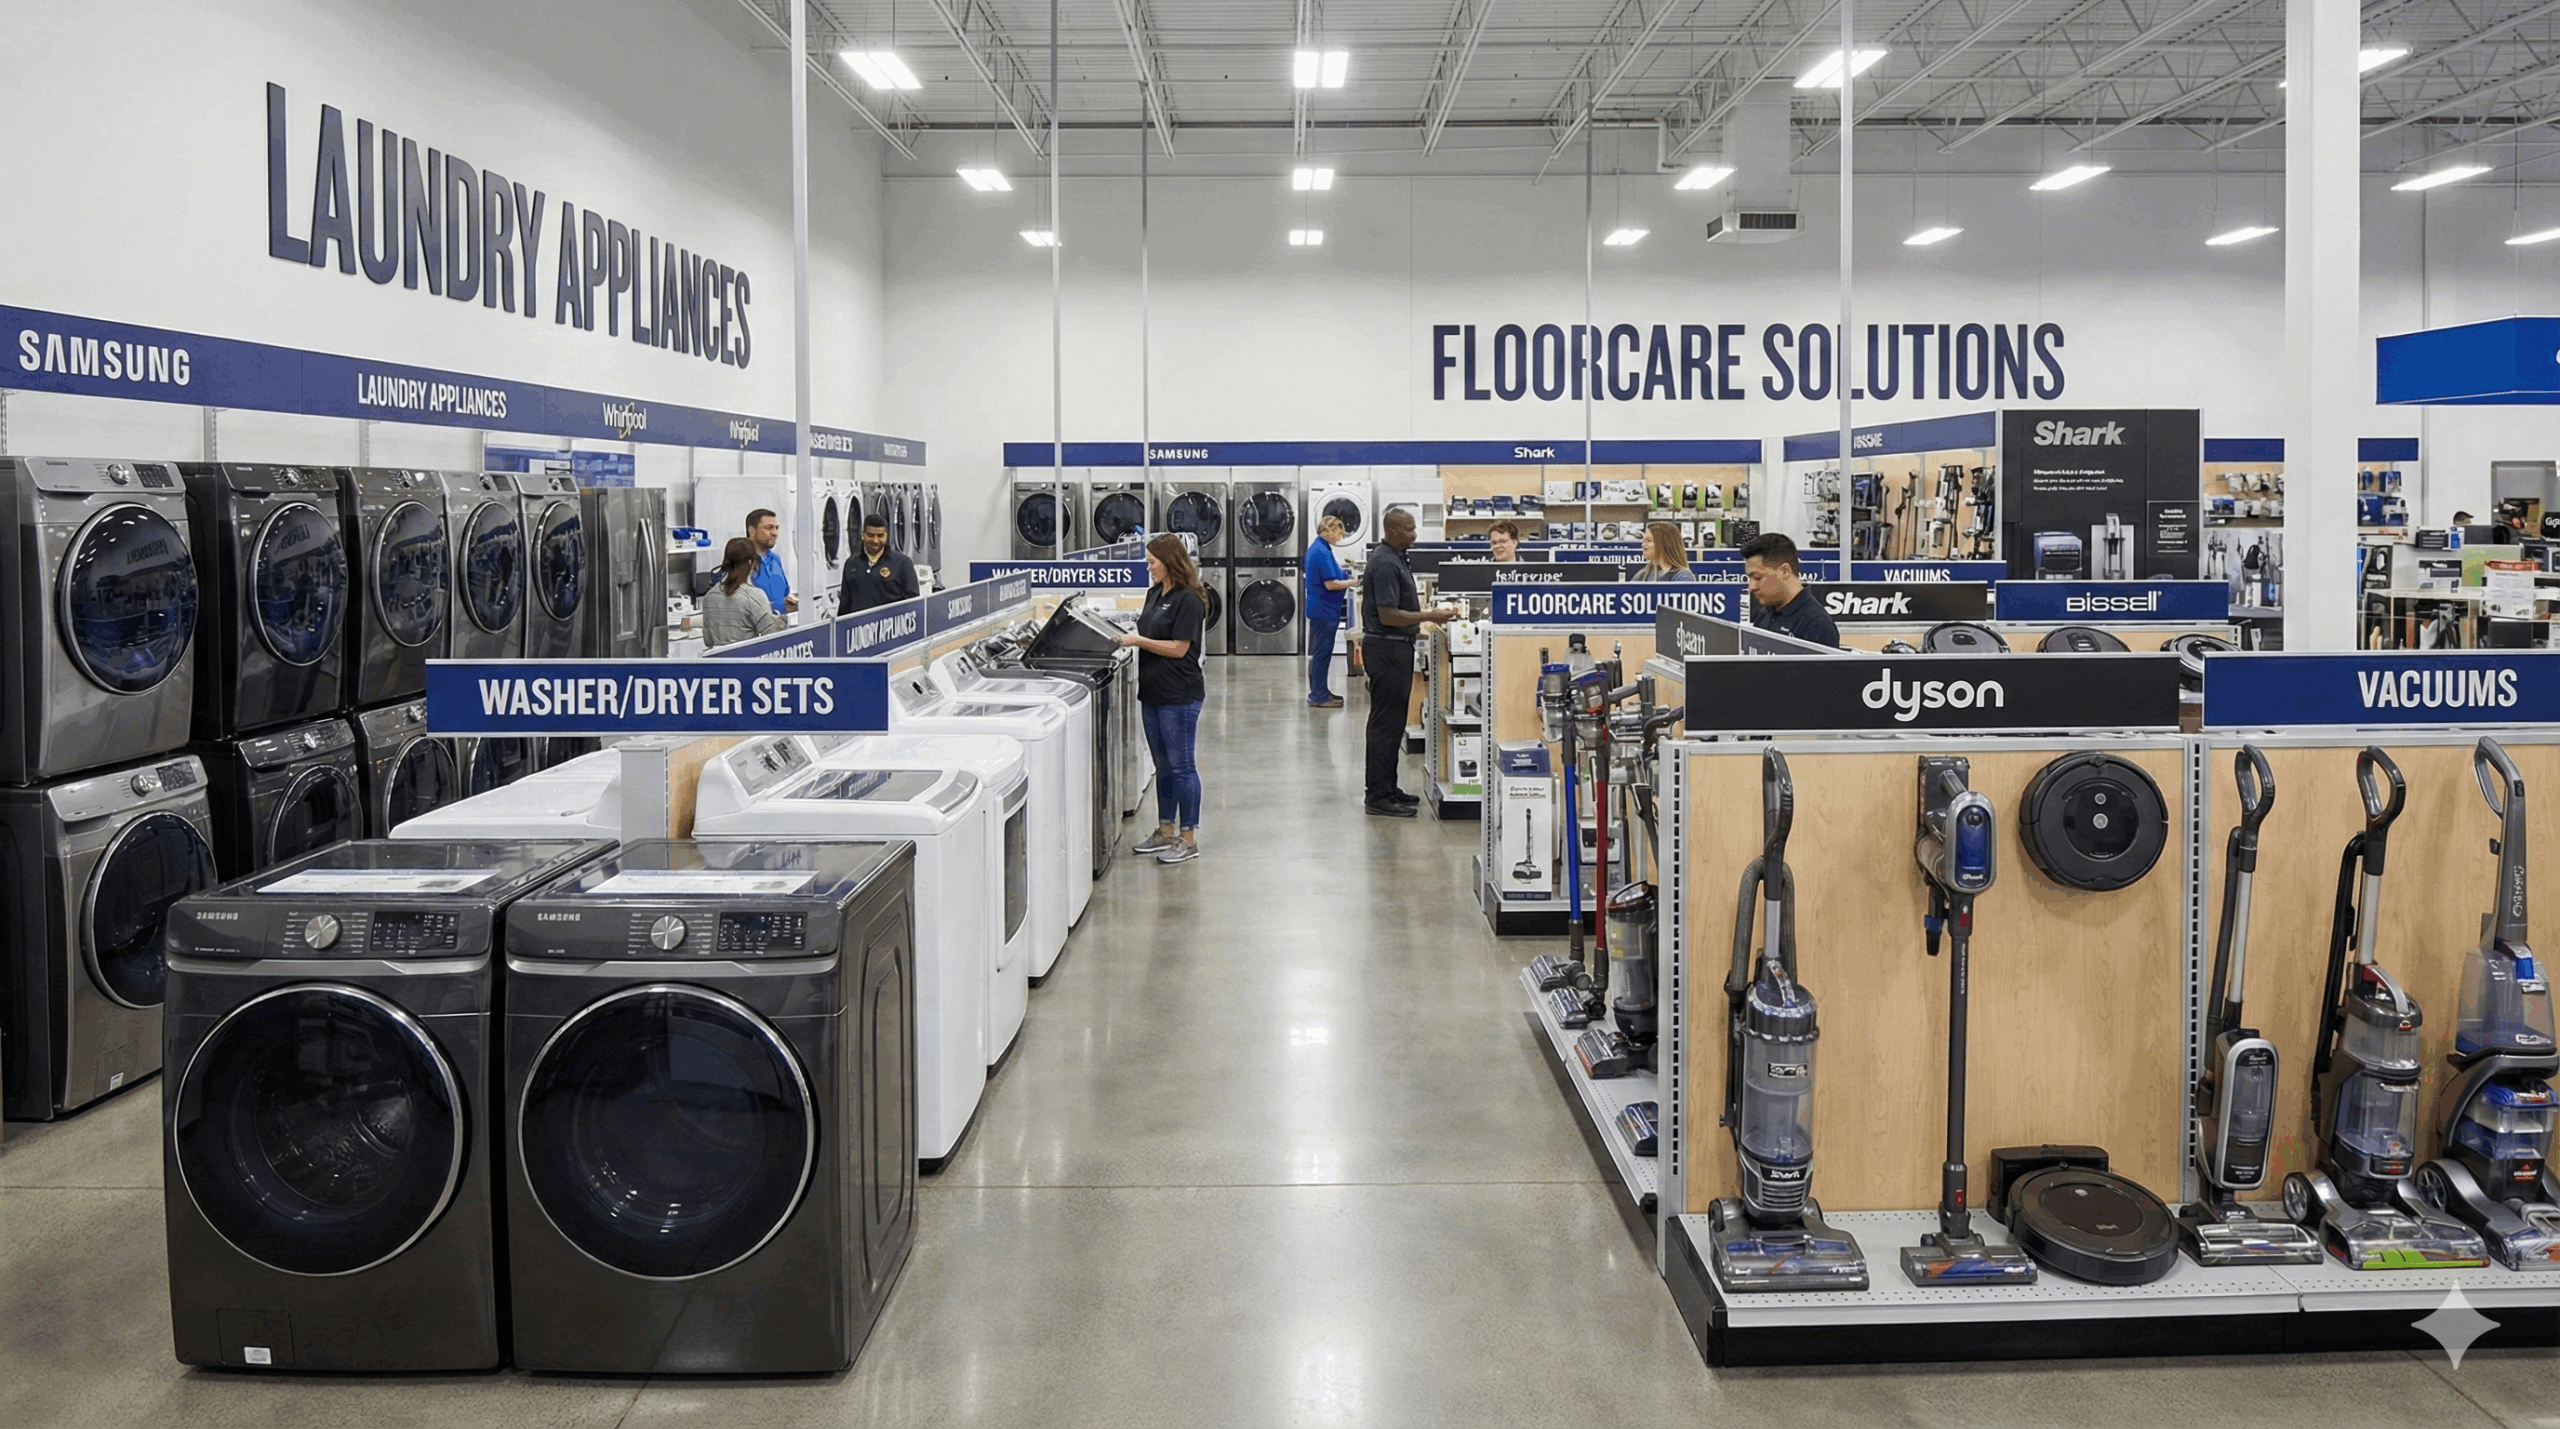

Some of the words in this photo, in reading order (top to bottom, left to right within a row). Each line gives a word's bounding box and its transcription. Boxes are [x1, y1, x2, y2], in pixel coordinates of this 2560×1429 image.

[266, 81, 546, 319] LAUNDRY
[555, 201, 751, 370] APPLIANCES
[18, 329, 191, 386] SAMSUNG
[1432, 323, 1746, 402] FLOORCARE
[357, 373, 427, 411] LAUNDRY
[429, 382, 507, 419] APPLIANCES
[1513, 446, 1556, 459] Shark
[2033, 420, 2126, 446] Shark
[1148, 448, 1209, 460] SAMSUNG
[992, 566, 1097, 584] WER/DRYER
[1099, 568, 1132, 583] SETS
[1506, 593, 1616, 615] FLOORCARE
[1620, 592, 1726, 615] SOLUTIONS
[1824, 591, 1912, 615] Shark
[478, 675, 743, 719] WASHER/DRYER
[751, 676, 835, 715] SETS
[1861, 668, 2005, 722] dyson
[2357, 668, 2518, 709] VACUUMS
